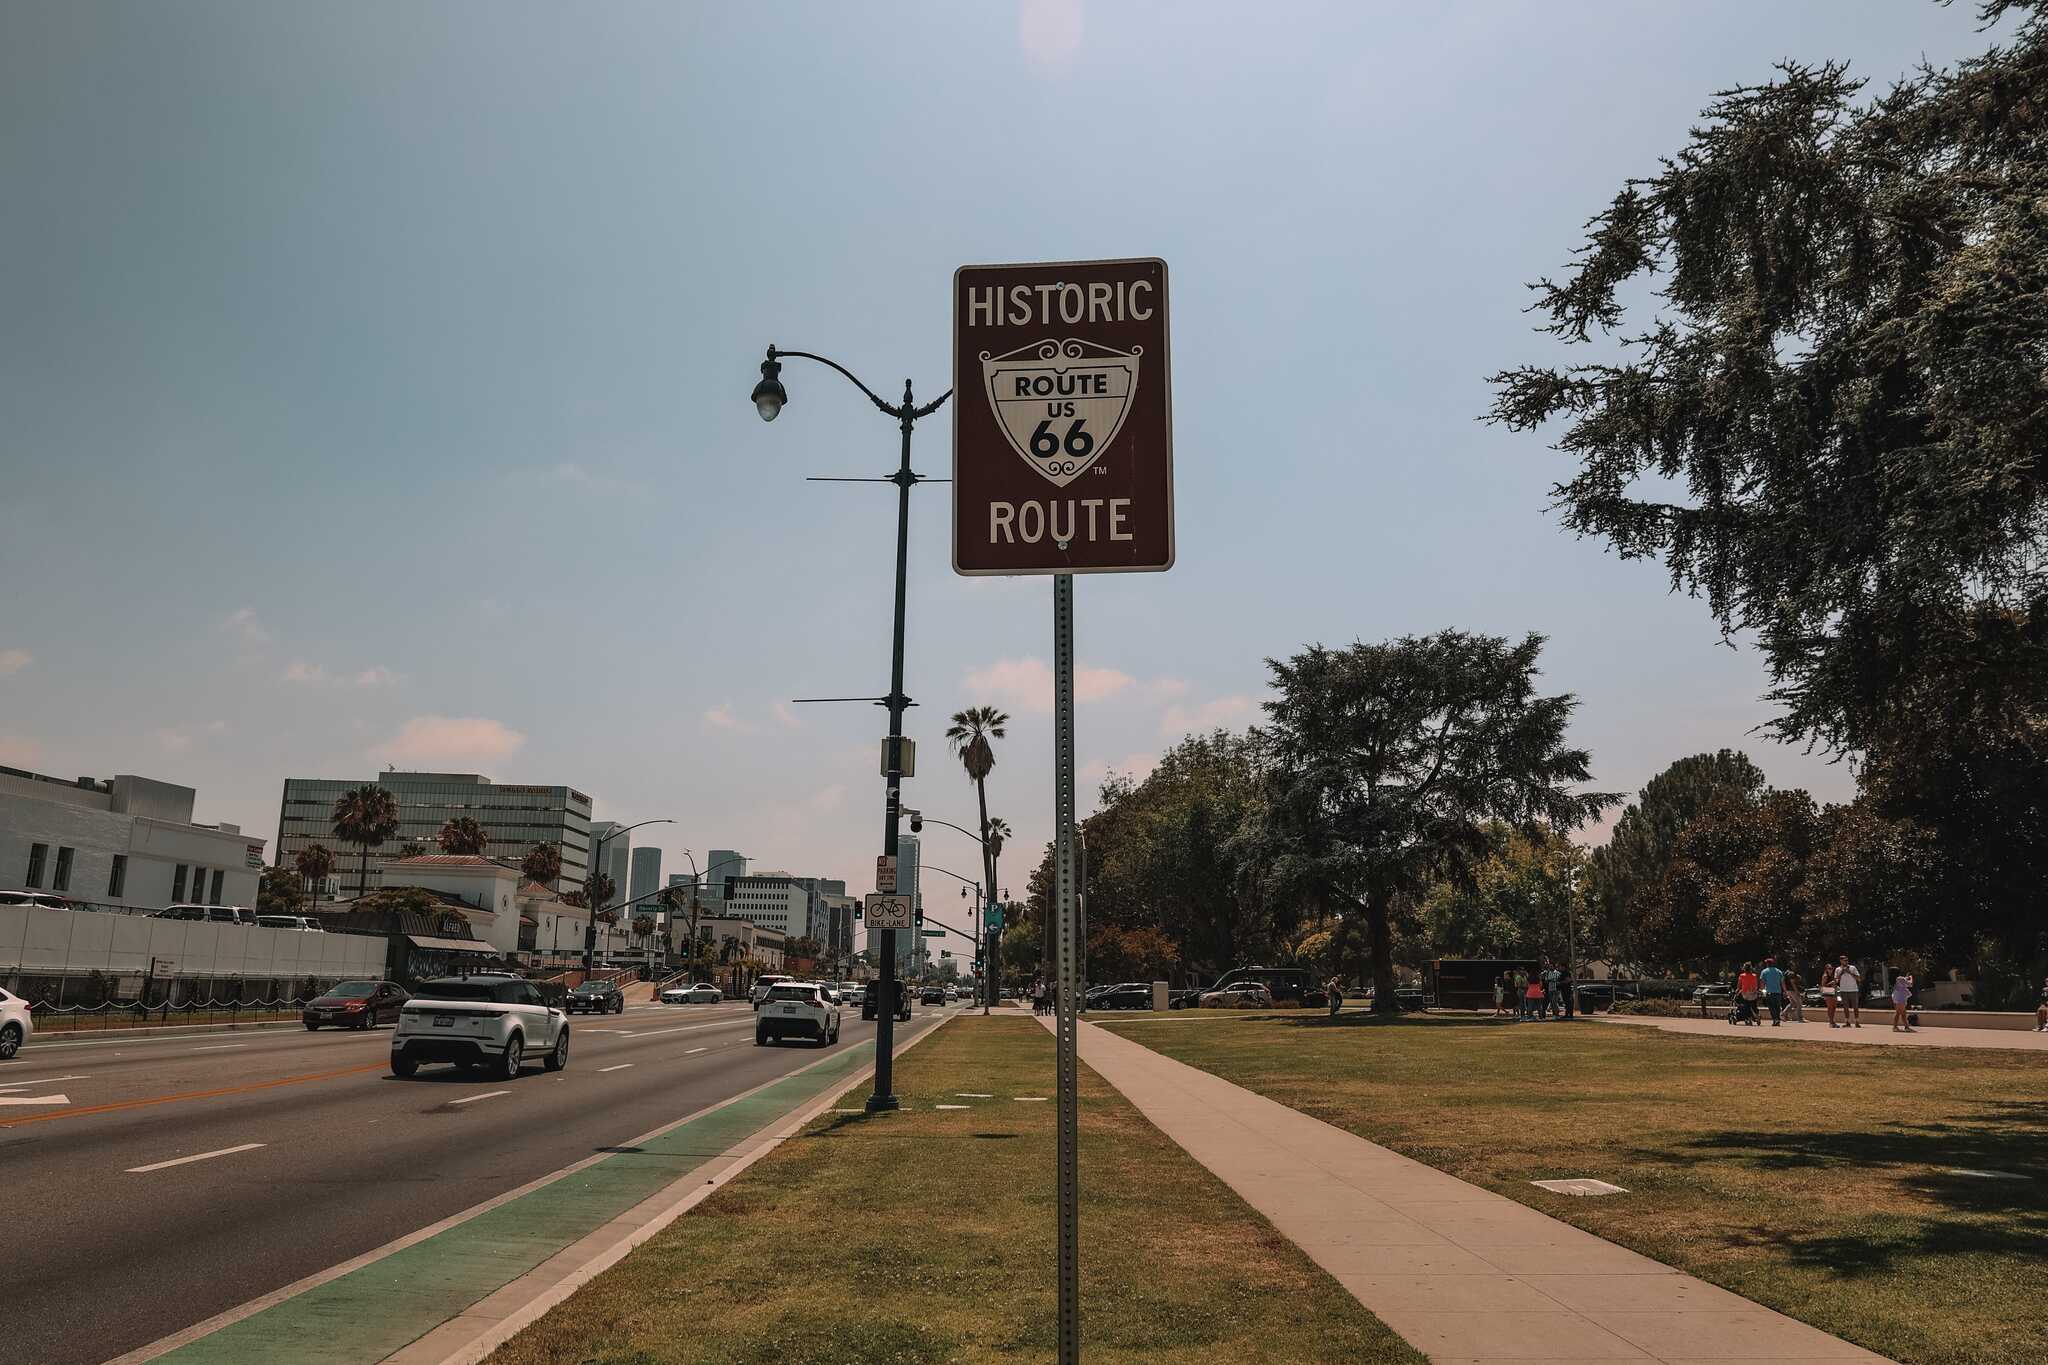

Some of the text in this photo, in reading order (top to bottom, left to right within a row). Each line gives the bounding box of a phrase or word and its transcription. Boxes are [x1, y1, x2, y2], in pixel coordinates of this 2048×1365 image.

[967, 279, 1153, 327] HISTORIC
[1015, 373, 1108, 397] ROUTE
[1047, 401, 1075, 419] US
[1029, 418, 1094, 459] 66
[1093, 466, 1107, 476] TM
[989, 498, 1134, 544] ROUTE
[870, 919, 905, 928] BIKE LANE
